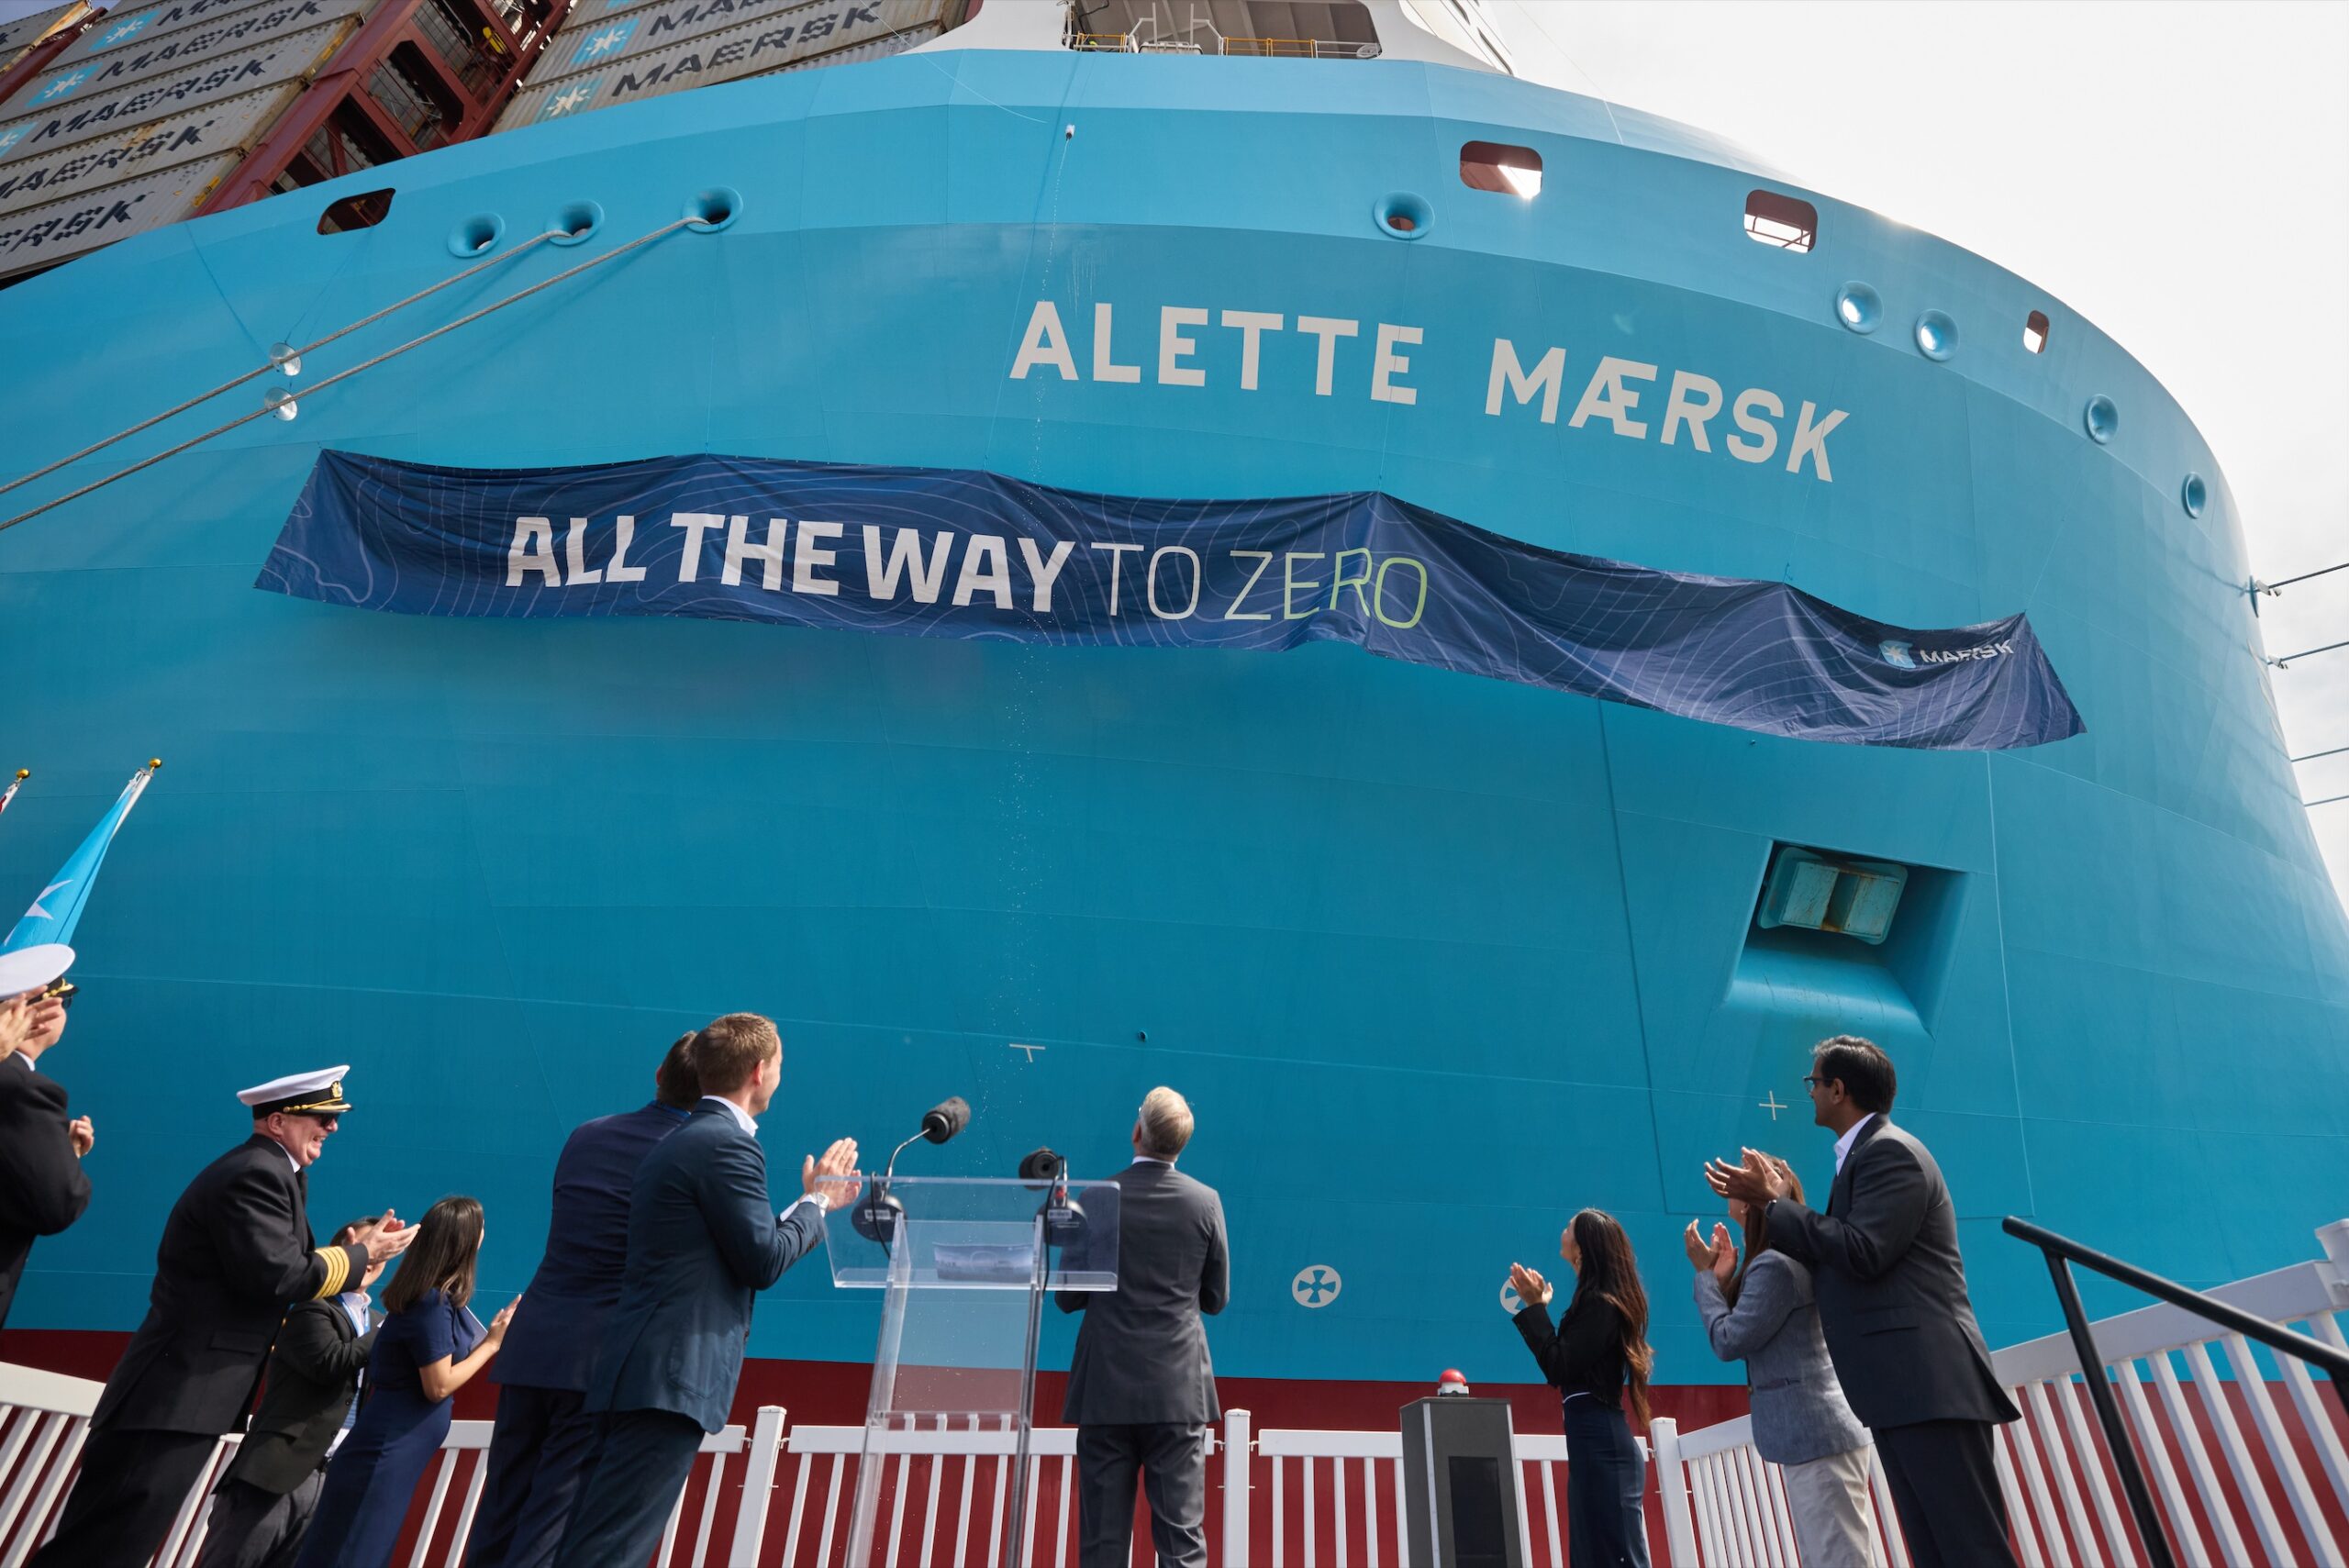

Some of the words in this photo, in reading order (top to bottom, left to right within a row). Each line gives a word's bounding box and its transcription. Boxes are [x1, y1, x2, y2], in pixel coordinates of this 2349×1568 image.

[96, 0, 323, 81] MAERSK
[611, 0, 883, 97] MAERSK
[30, 50, 283, 143] MAERSK
[1009, 301, 1424, 406] ALETTE
[1485, 338, 1851, 483] MÆRSK
[506, 515, 647, 588] ALL
[670, 512, 844, 595] THE
[863, 525, 1076, 613] WAY
[1090, 541, 1201, 620] TO
[1224, 547, 1428, 629] ZERO
